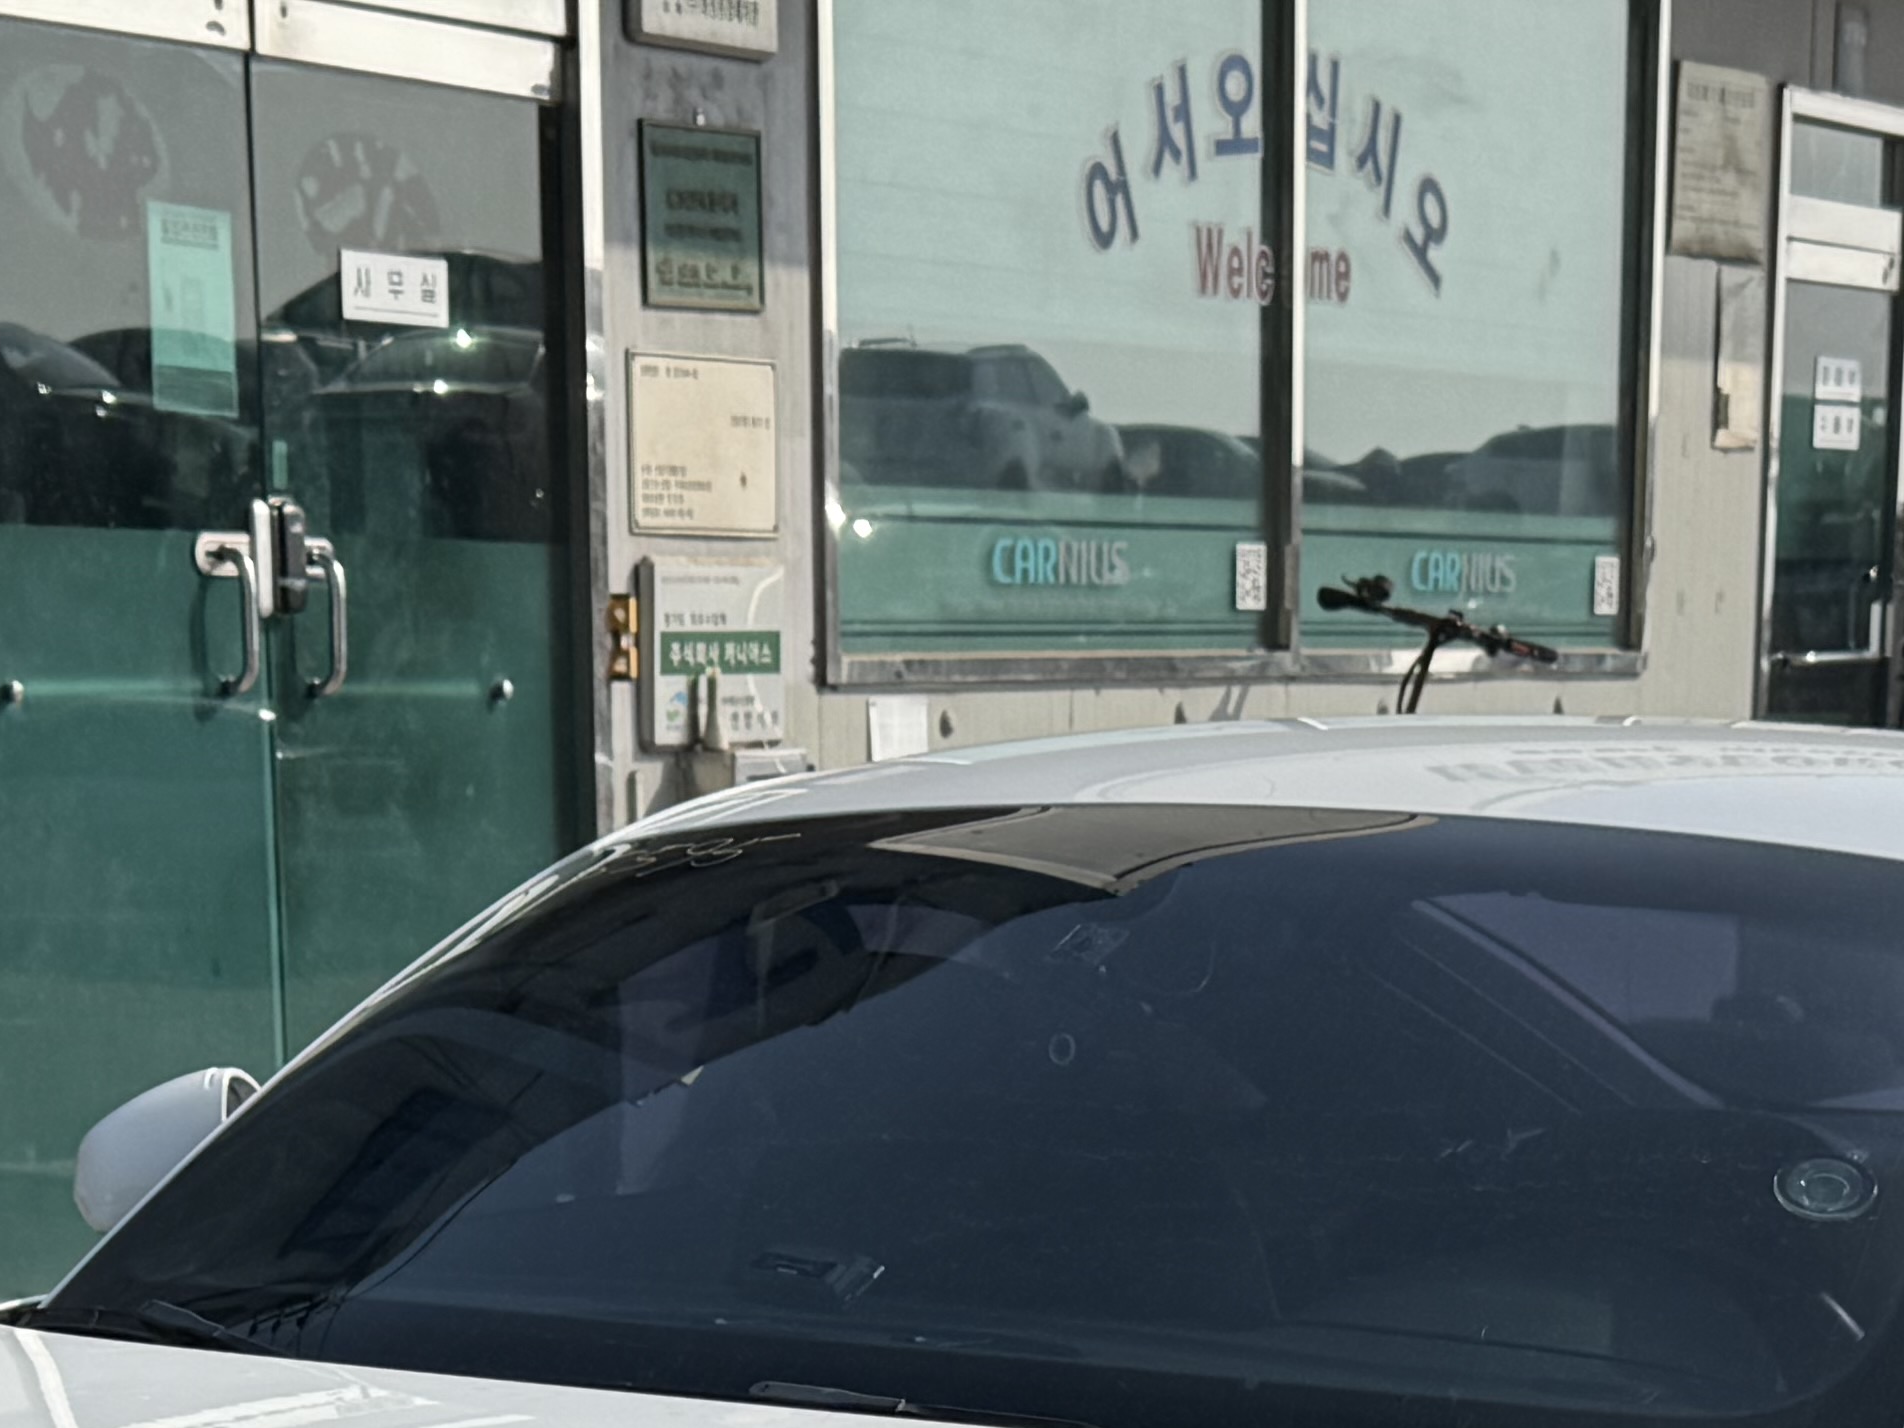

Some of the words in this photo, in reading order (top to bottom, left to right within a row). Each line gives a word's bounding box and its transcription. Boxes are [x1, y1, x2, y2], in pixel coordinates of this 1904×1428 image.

[1086, 53, 1449, 297] 어서오십시오
[1196, 222, 1352, 302] Welcme
[991, 537, 1130, 587] CARNIUS
